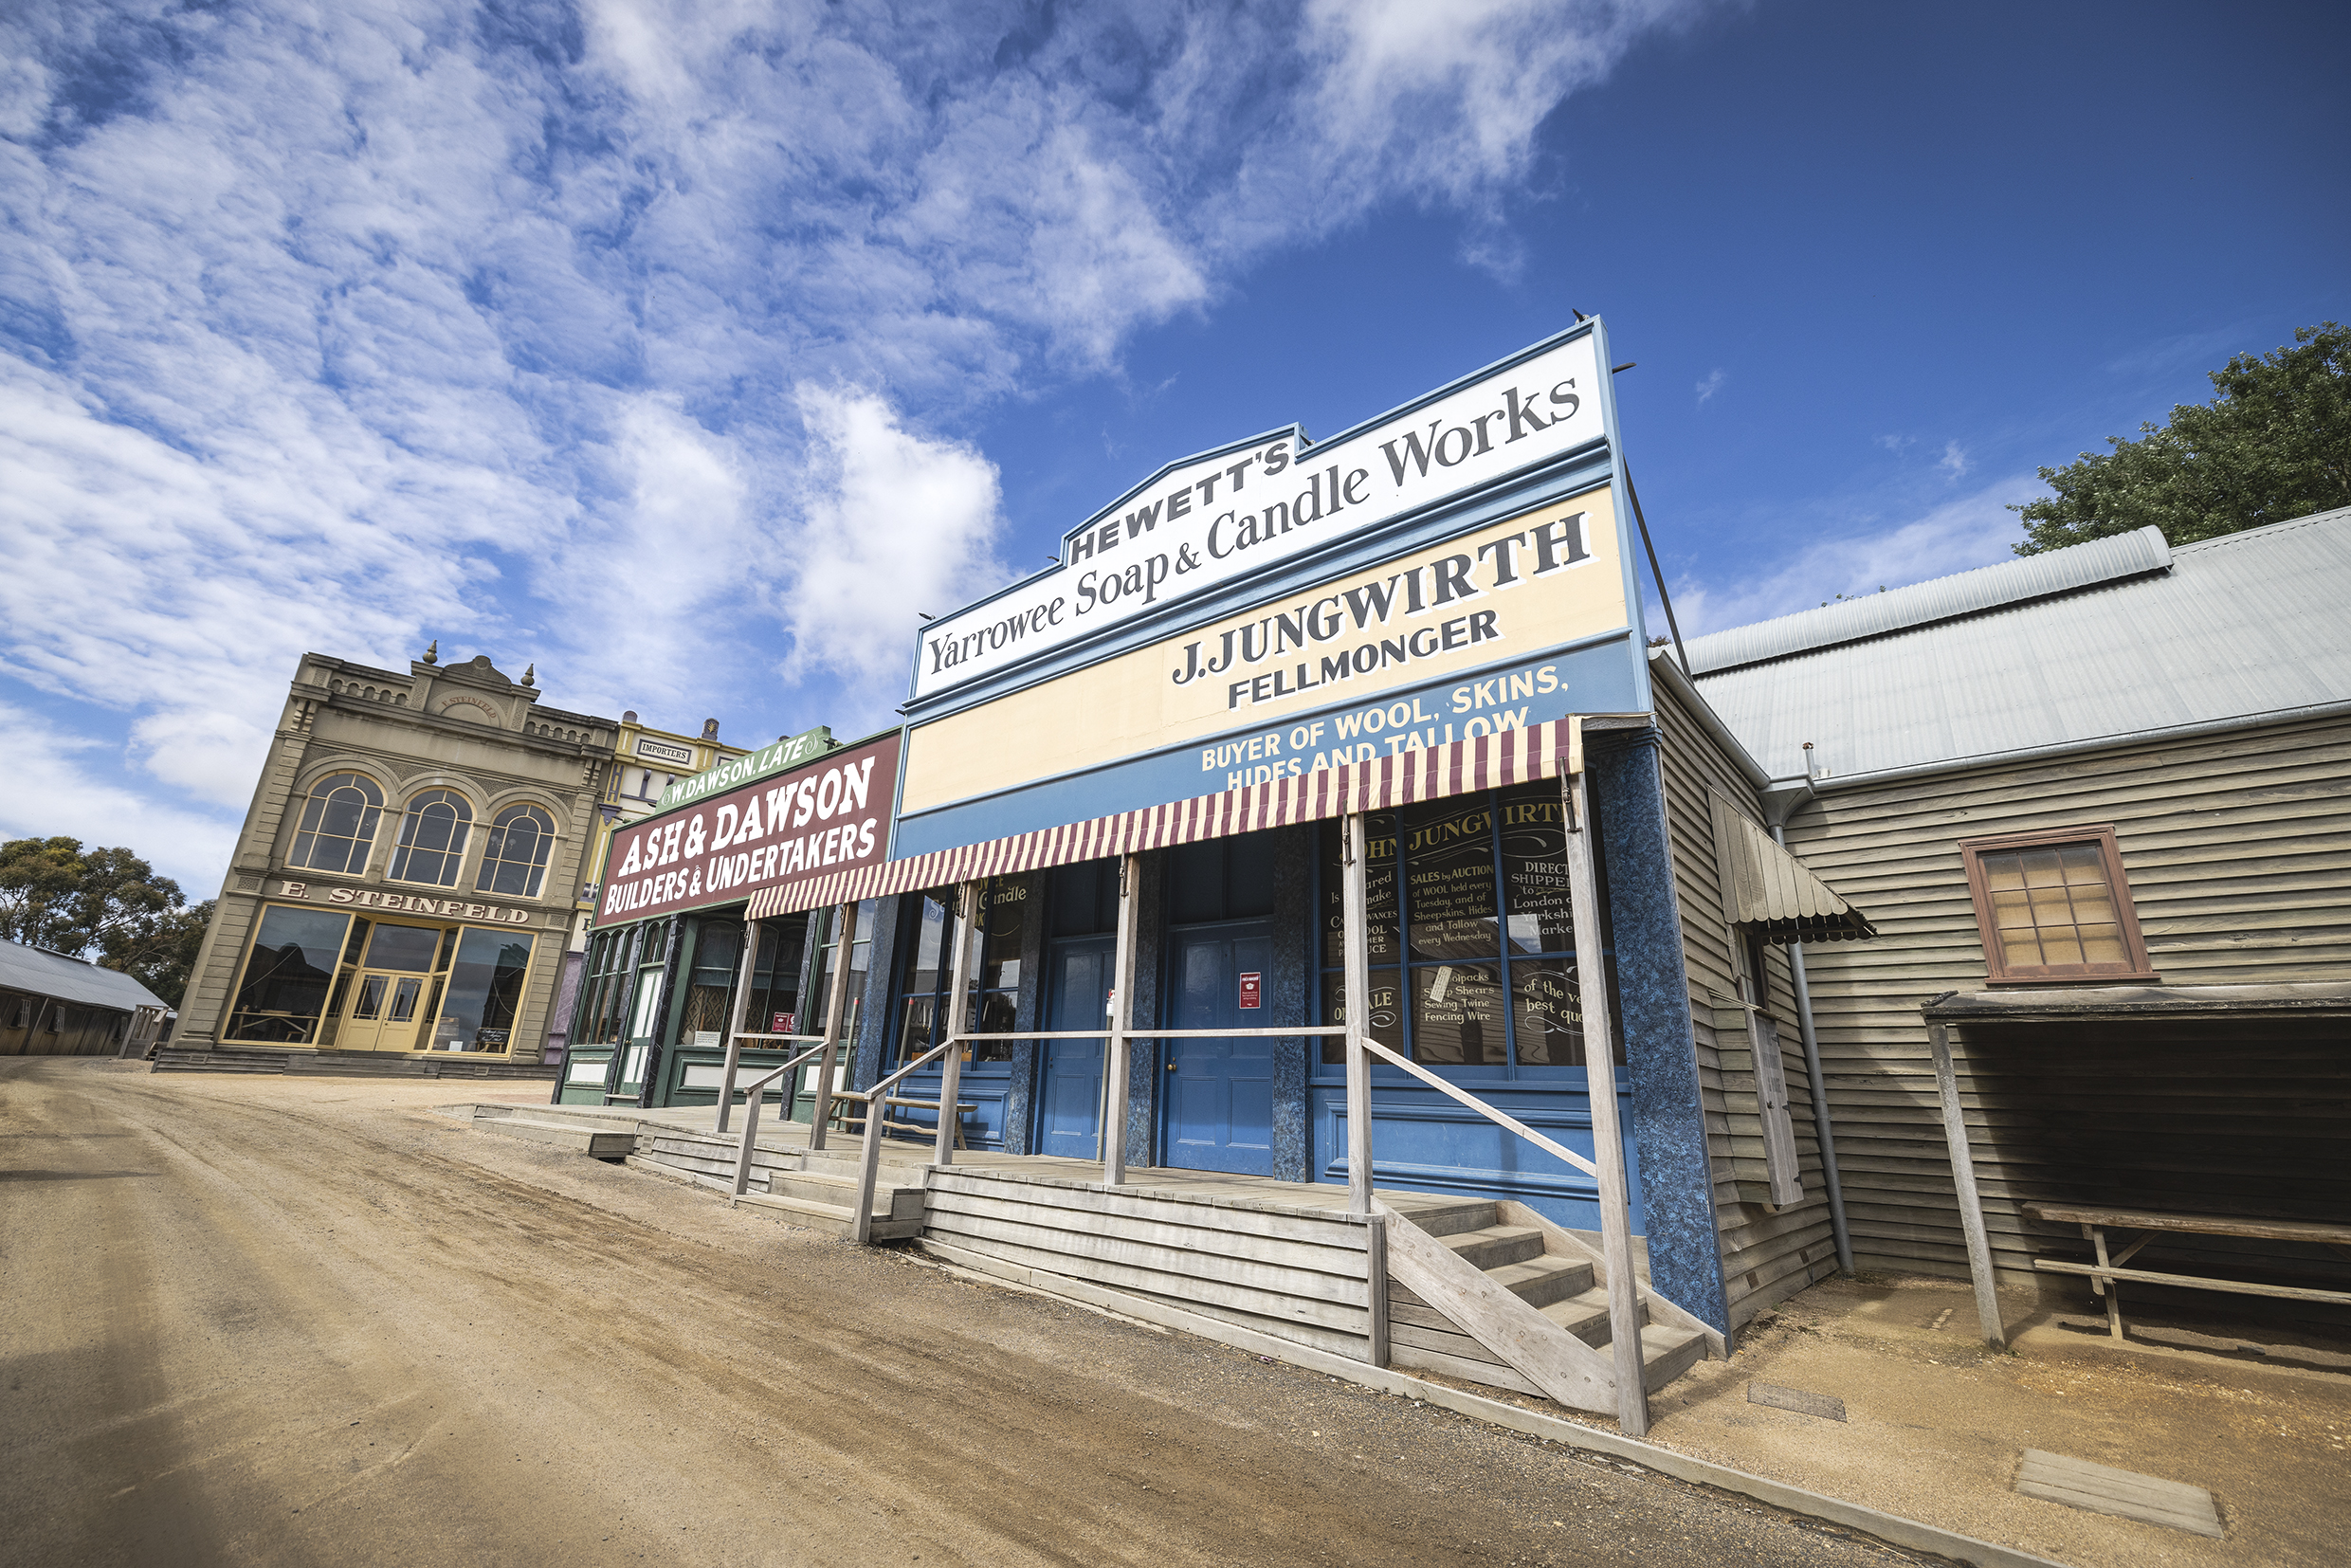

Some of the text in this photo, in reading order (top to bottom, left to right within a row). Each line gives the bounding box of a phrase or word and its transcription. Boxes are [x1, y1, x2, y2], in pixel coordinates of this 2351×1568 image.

[1070, 443, 1289, 566] HEWETT'S
[928, 377, 1580, 676] Yarrowee Soap & Candle Works
[1228, 610, 1500, 710] FELLMONGER
[449, 696, 497, 719] STEINFELD
[1202, 665, 1569, 772] BUYER OF WOOL, SKINS,
[642, 743, 687, 759] IMPORTERS
[758, 735, 808, 773] LATE
[617, 756, 876, 878] ASH & DAWSON
[604, 817, 877, 916] BUILDERS & UNDERTAKERS
[1410, 865, 1494, 885] SALES by AUCTION
[1412, 882, 1491, 898] of WOOL held every
[1455, 893, 1473, 904] and
[1477, 892, 1486, 902] of
[1522, 885, 1534, 895] to
[278, 881, 529, 924] E. STEINFELD
[1468, 904, 1493, 916] Hides
[1513, 896, 1562, 909] London
[1521, 908, 1574, 922] Yorkshi
[1425, 919, 1478, 932] and Tallow
[1529, 923, 1574, 936] Marke
[1418, 930, 1491, 946] every Wednesday
[1455, 986, 1495, 995] Shears
[1523, 978, 1538, 993] of
[1542, 980, 1564, 999] the
[1424, 998, 1490, 1012] Sewing Twine
[1524, 997, 1556, 1014] best
[1425, 1011, 1491, 1025] Fencing Wire
